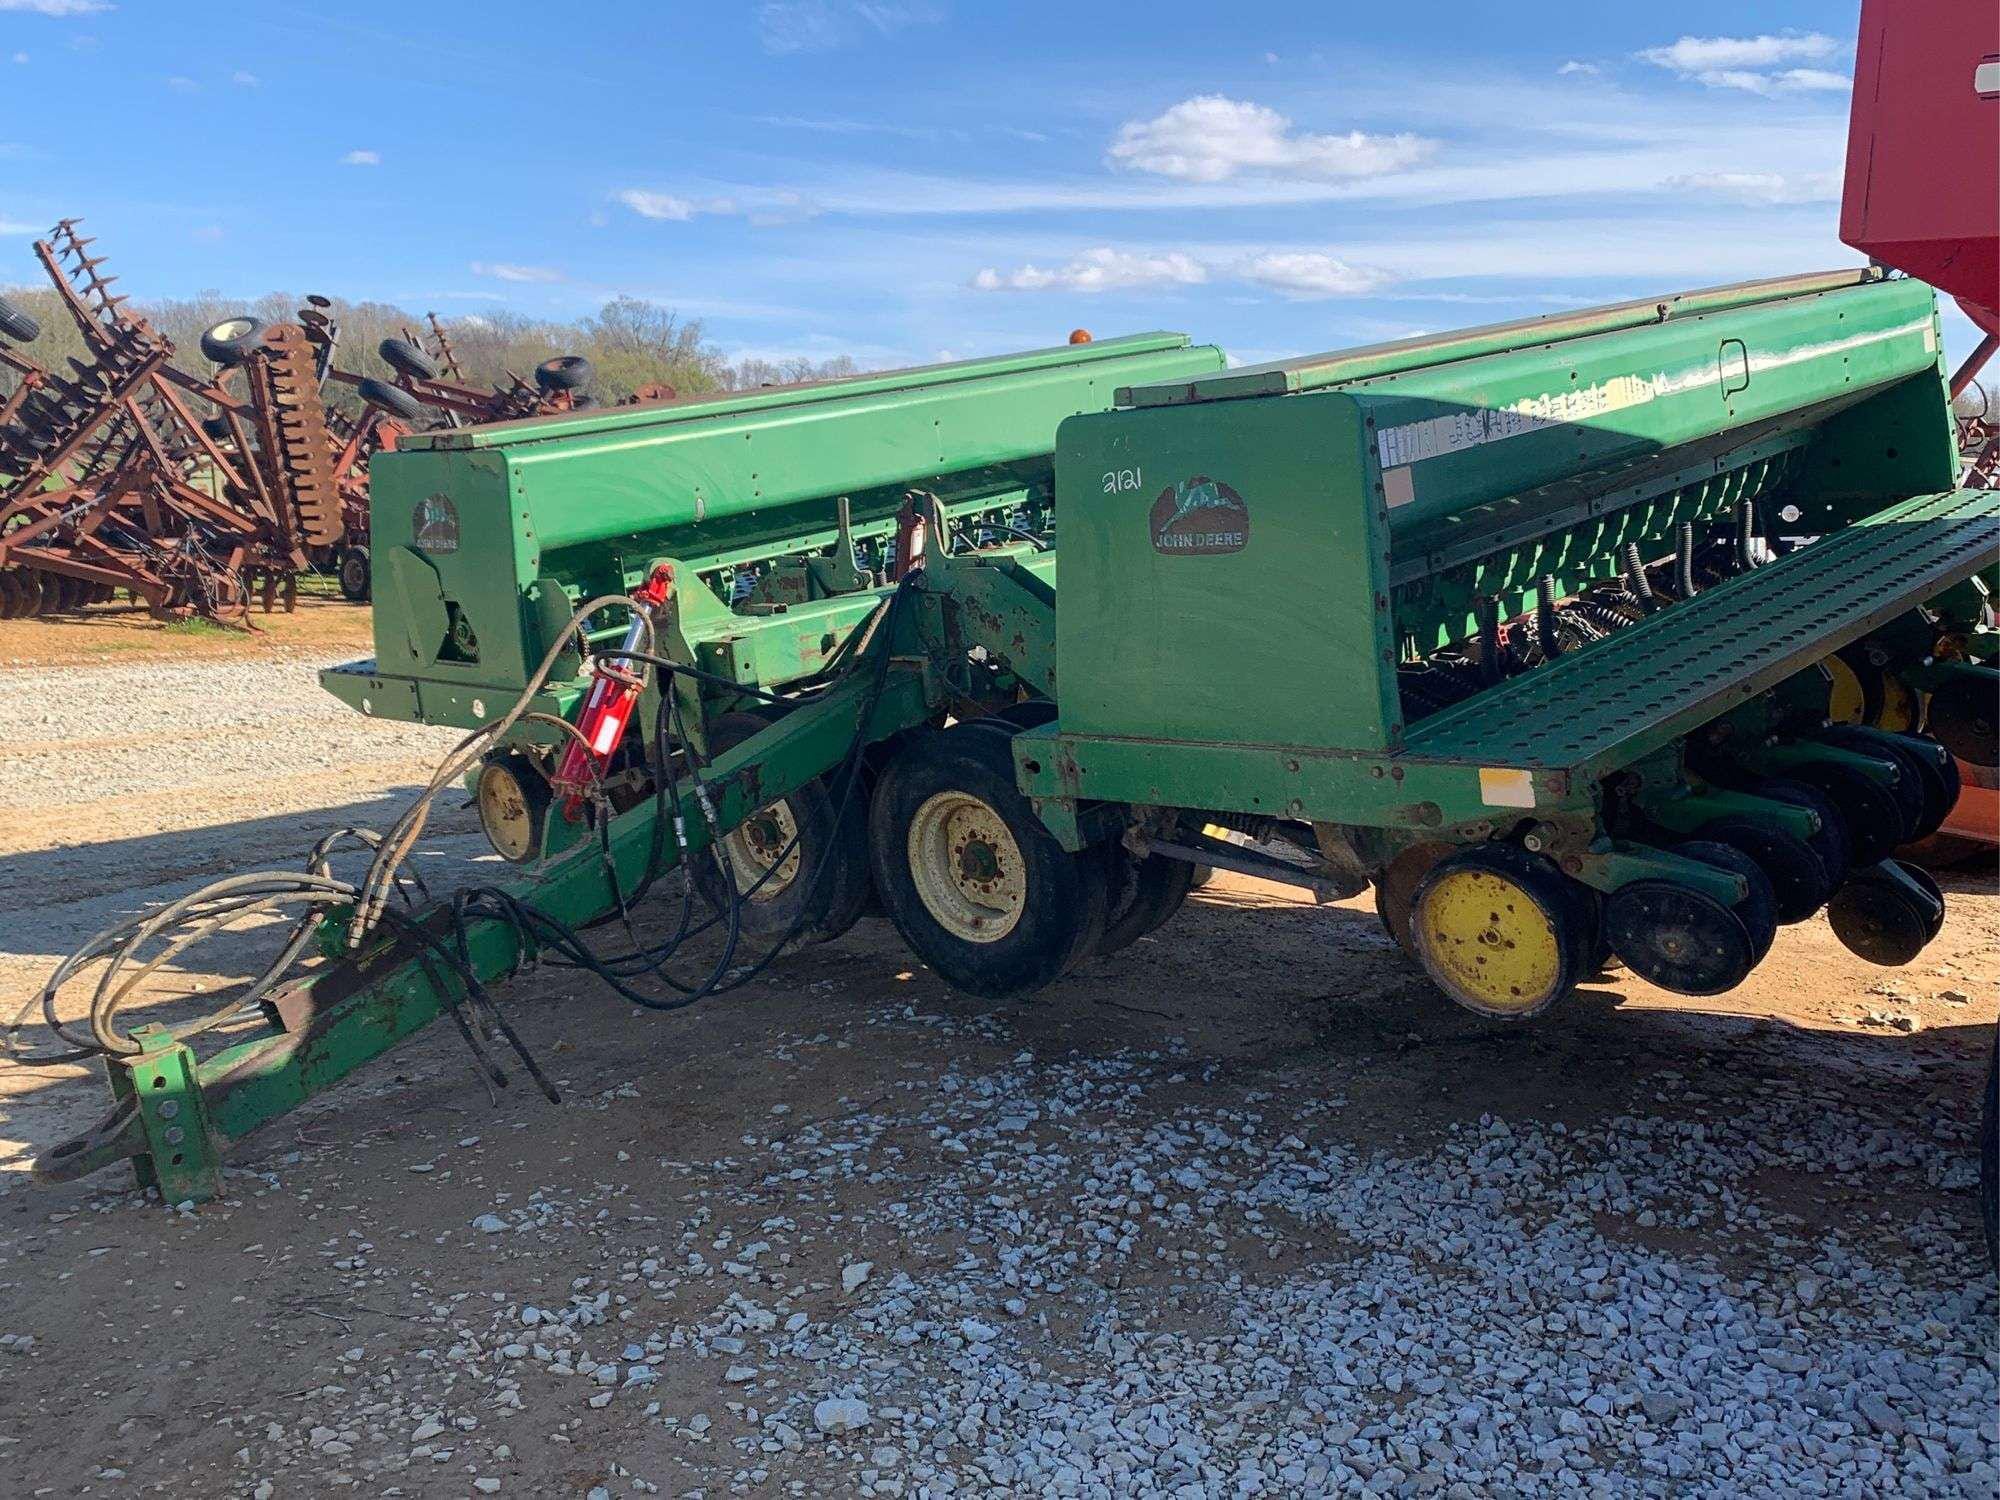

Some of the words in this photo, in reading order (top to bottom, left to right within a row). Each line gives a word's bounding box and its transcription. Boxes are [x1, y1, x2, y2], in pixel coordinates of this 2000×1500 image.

[1101, 466, 1142, 495] 2121
[1156, 533, 1193, 548] JOHN
[1196, 532, 1243, 546] DEERE
